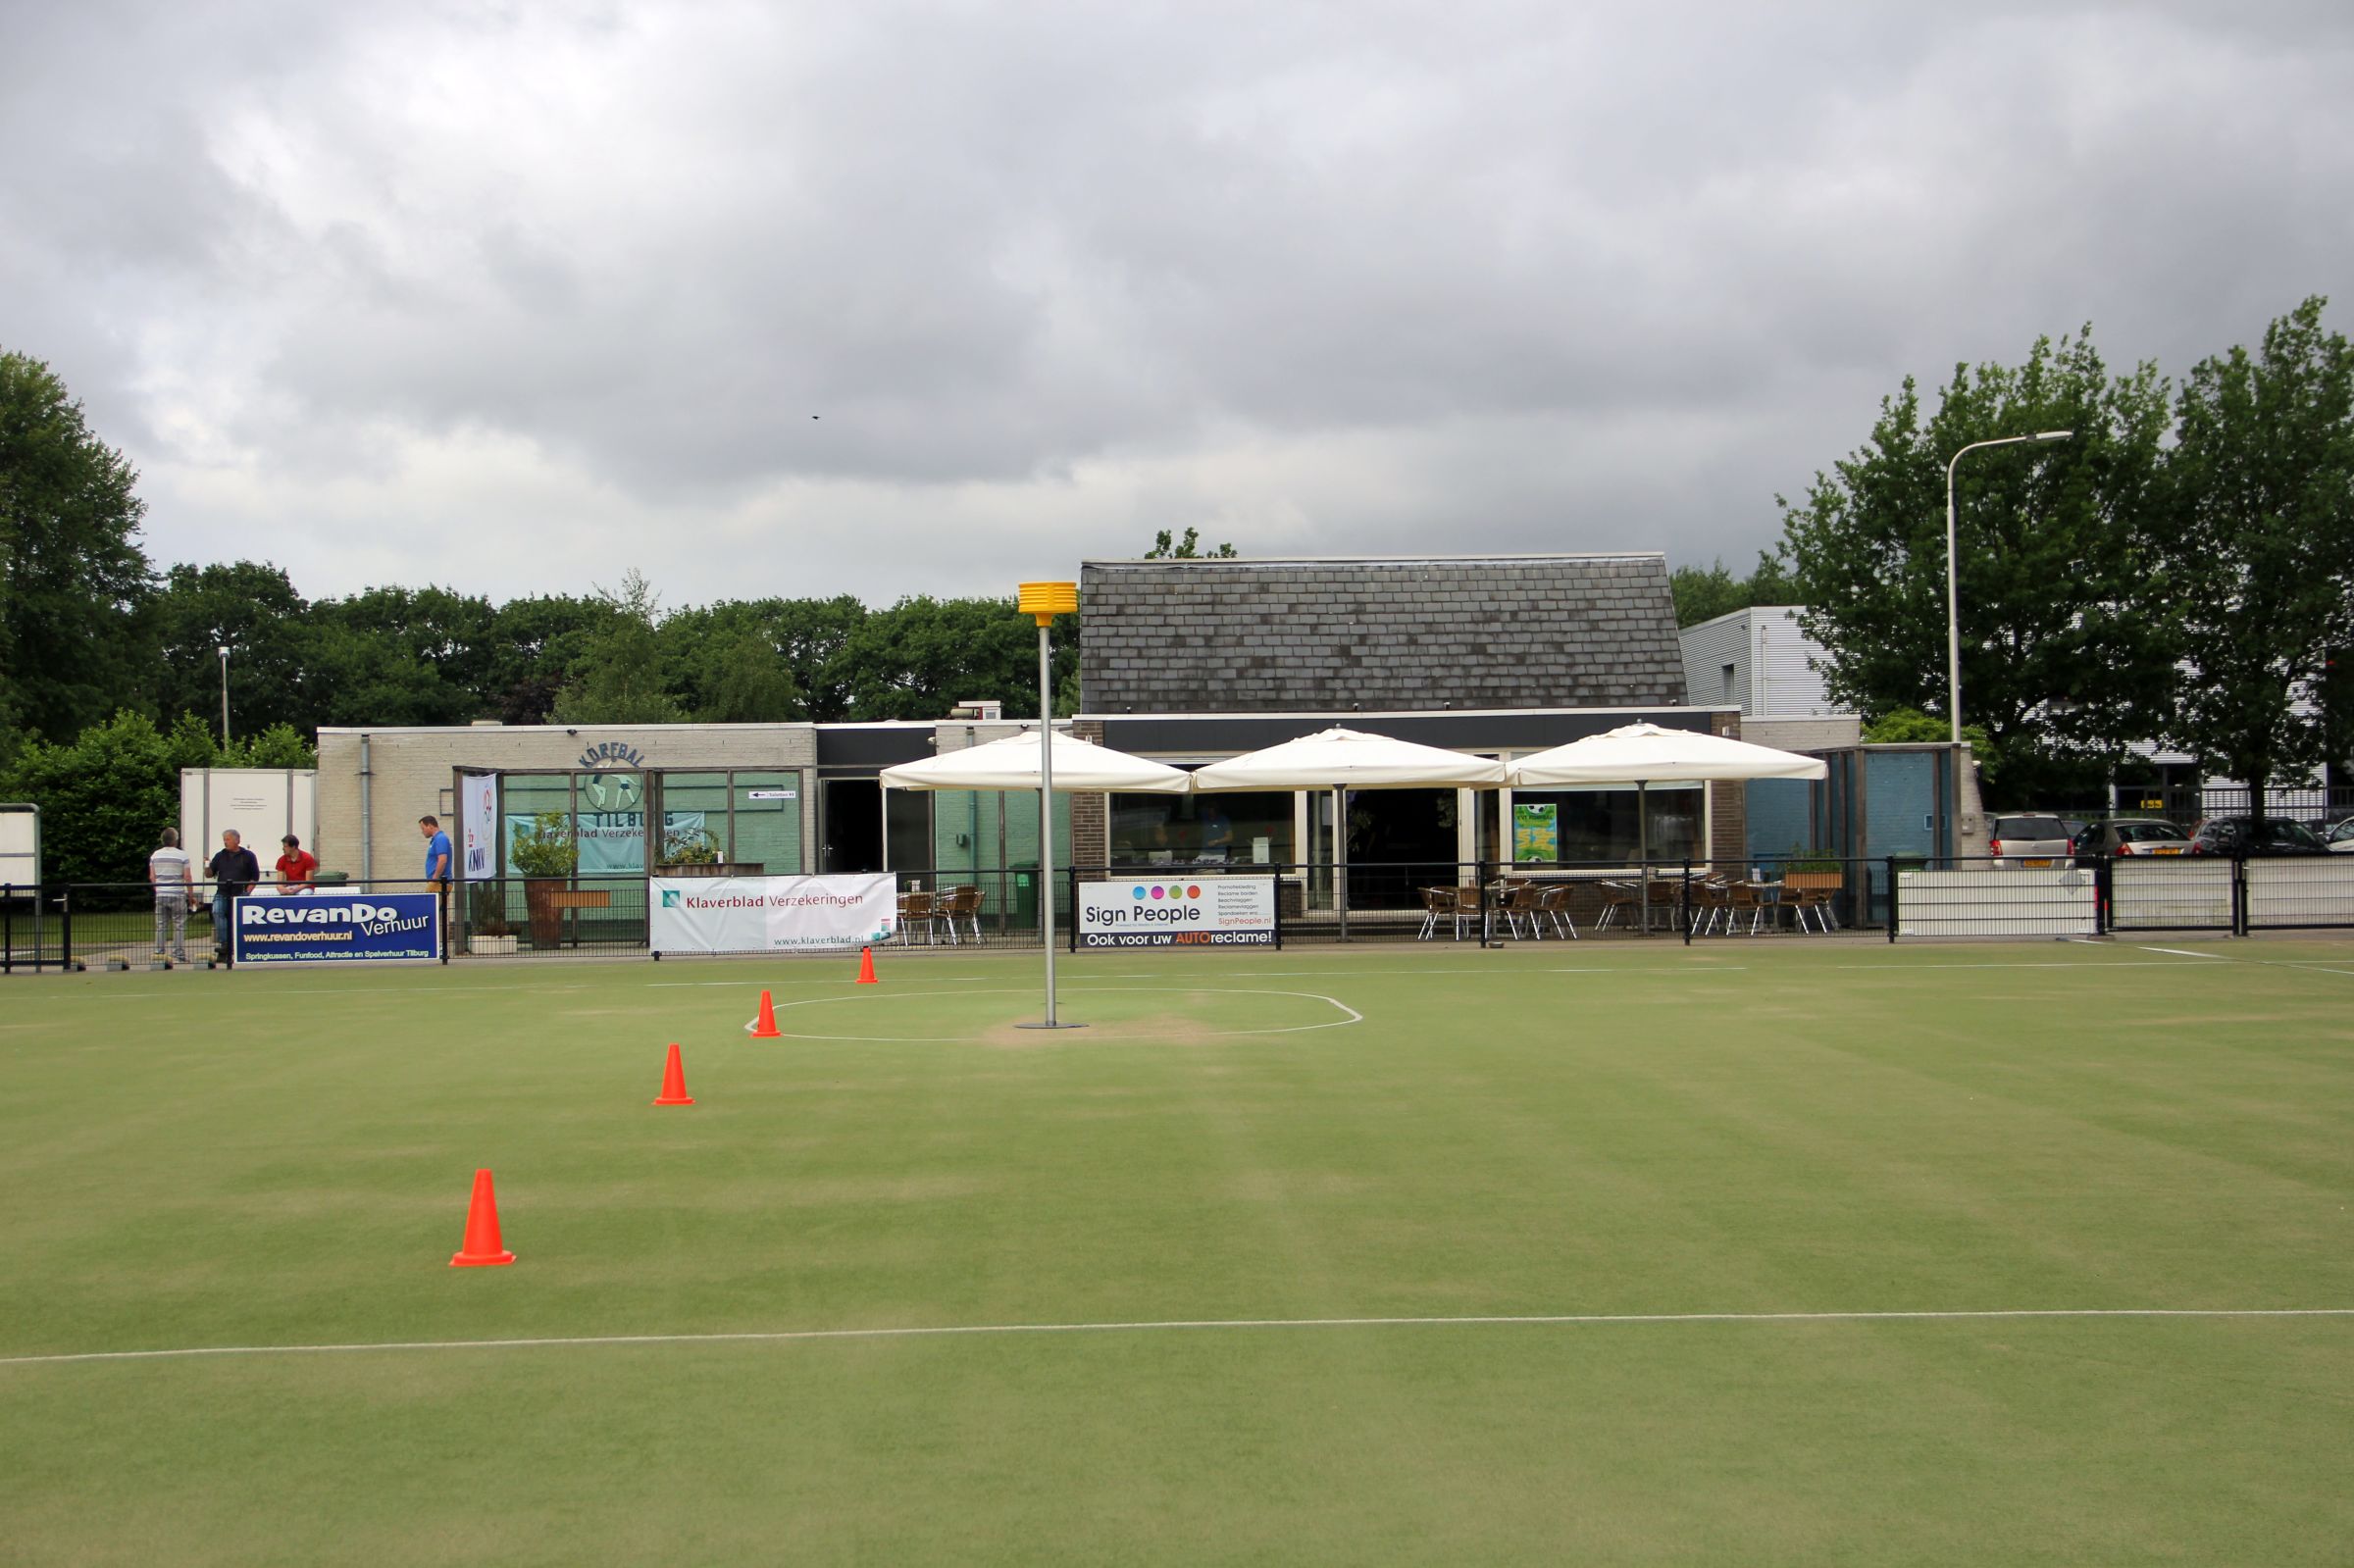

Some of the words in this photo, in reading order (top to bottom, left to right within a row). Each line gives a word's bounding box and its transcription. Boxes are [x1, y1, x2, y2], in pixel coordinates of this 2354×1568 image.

[579, 741, 644, 768] KORFBAL
[687, 894, 764, 909] Klaverblad
[769, 892, 863, 908] Verzekeringen
[242, 903, 397, 925] RevanDo
[1086, 906, 1126, 926] Sign
[1134, 905, 1201, 924] People
[1218, 917, 1271, 926] SignPeople.nl
[361, 915, 430, 936] Verhuur
[244, 931, 353, 942] www.revandoverhuur.nl
[774, 936, 864, 945] www.klaverblad.nl
[1087, 934, 1115, 946] Ook
[1118, 935, 1149, 945] voor
[1152, 935, 1172, 945] uw
[1176, 931, 1272, 944] AUTOreclame!
[294, 951, 324, 960] Funfood,
[406, 949, 430, 958] Tilburg
